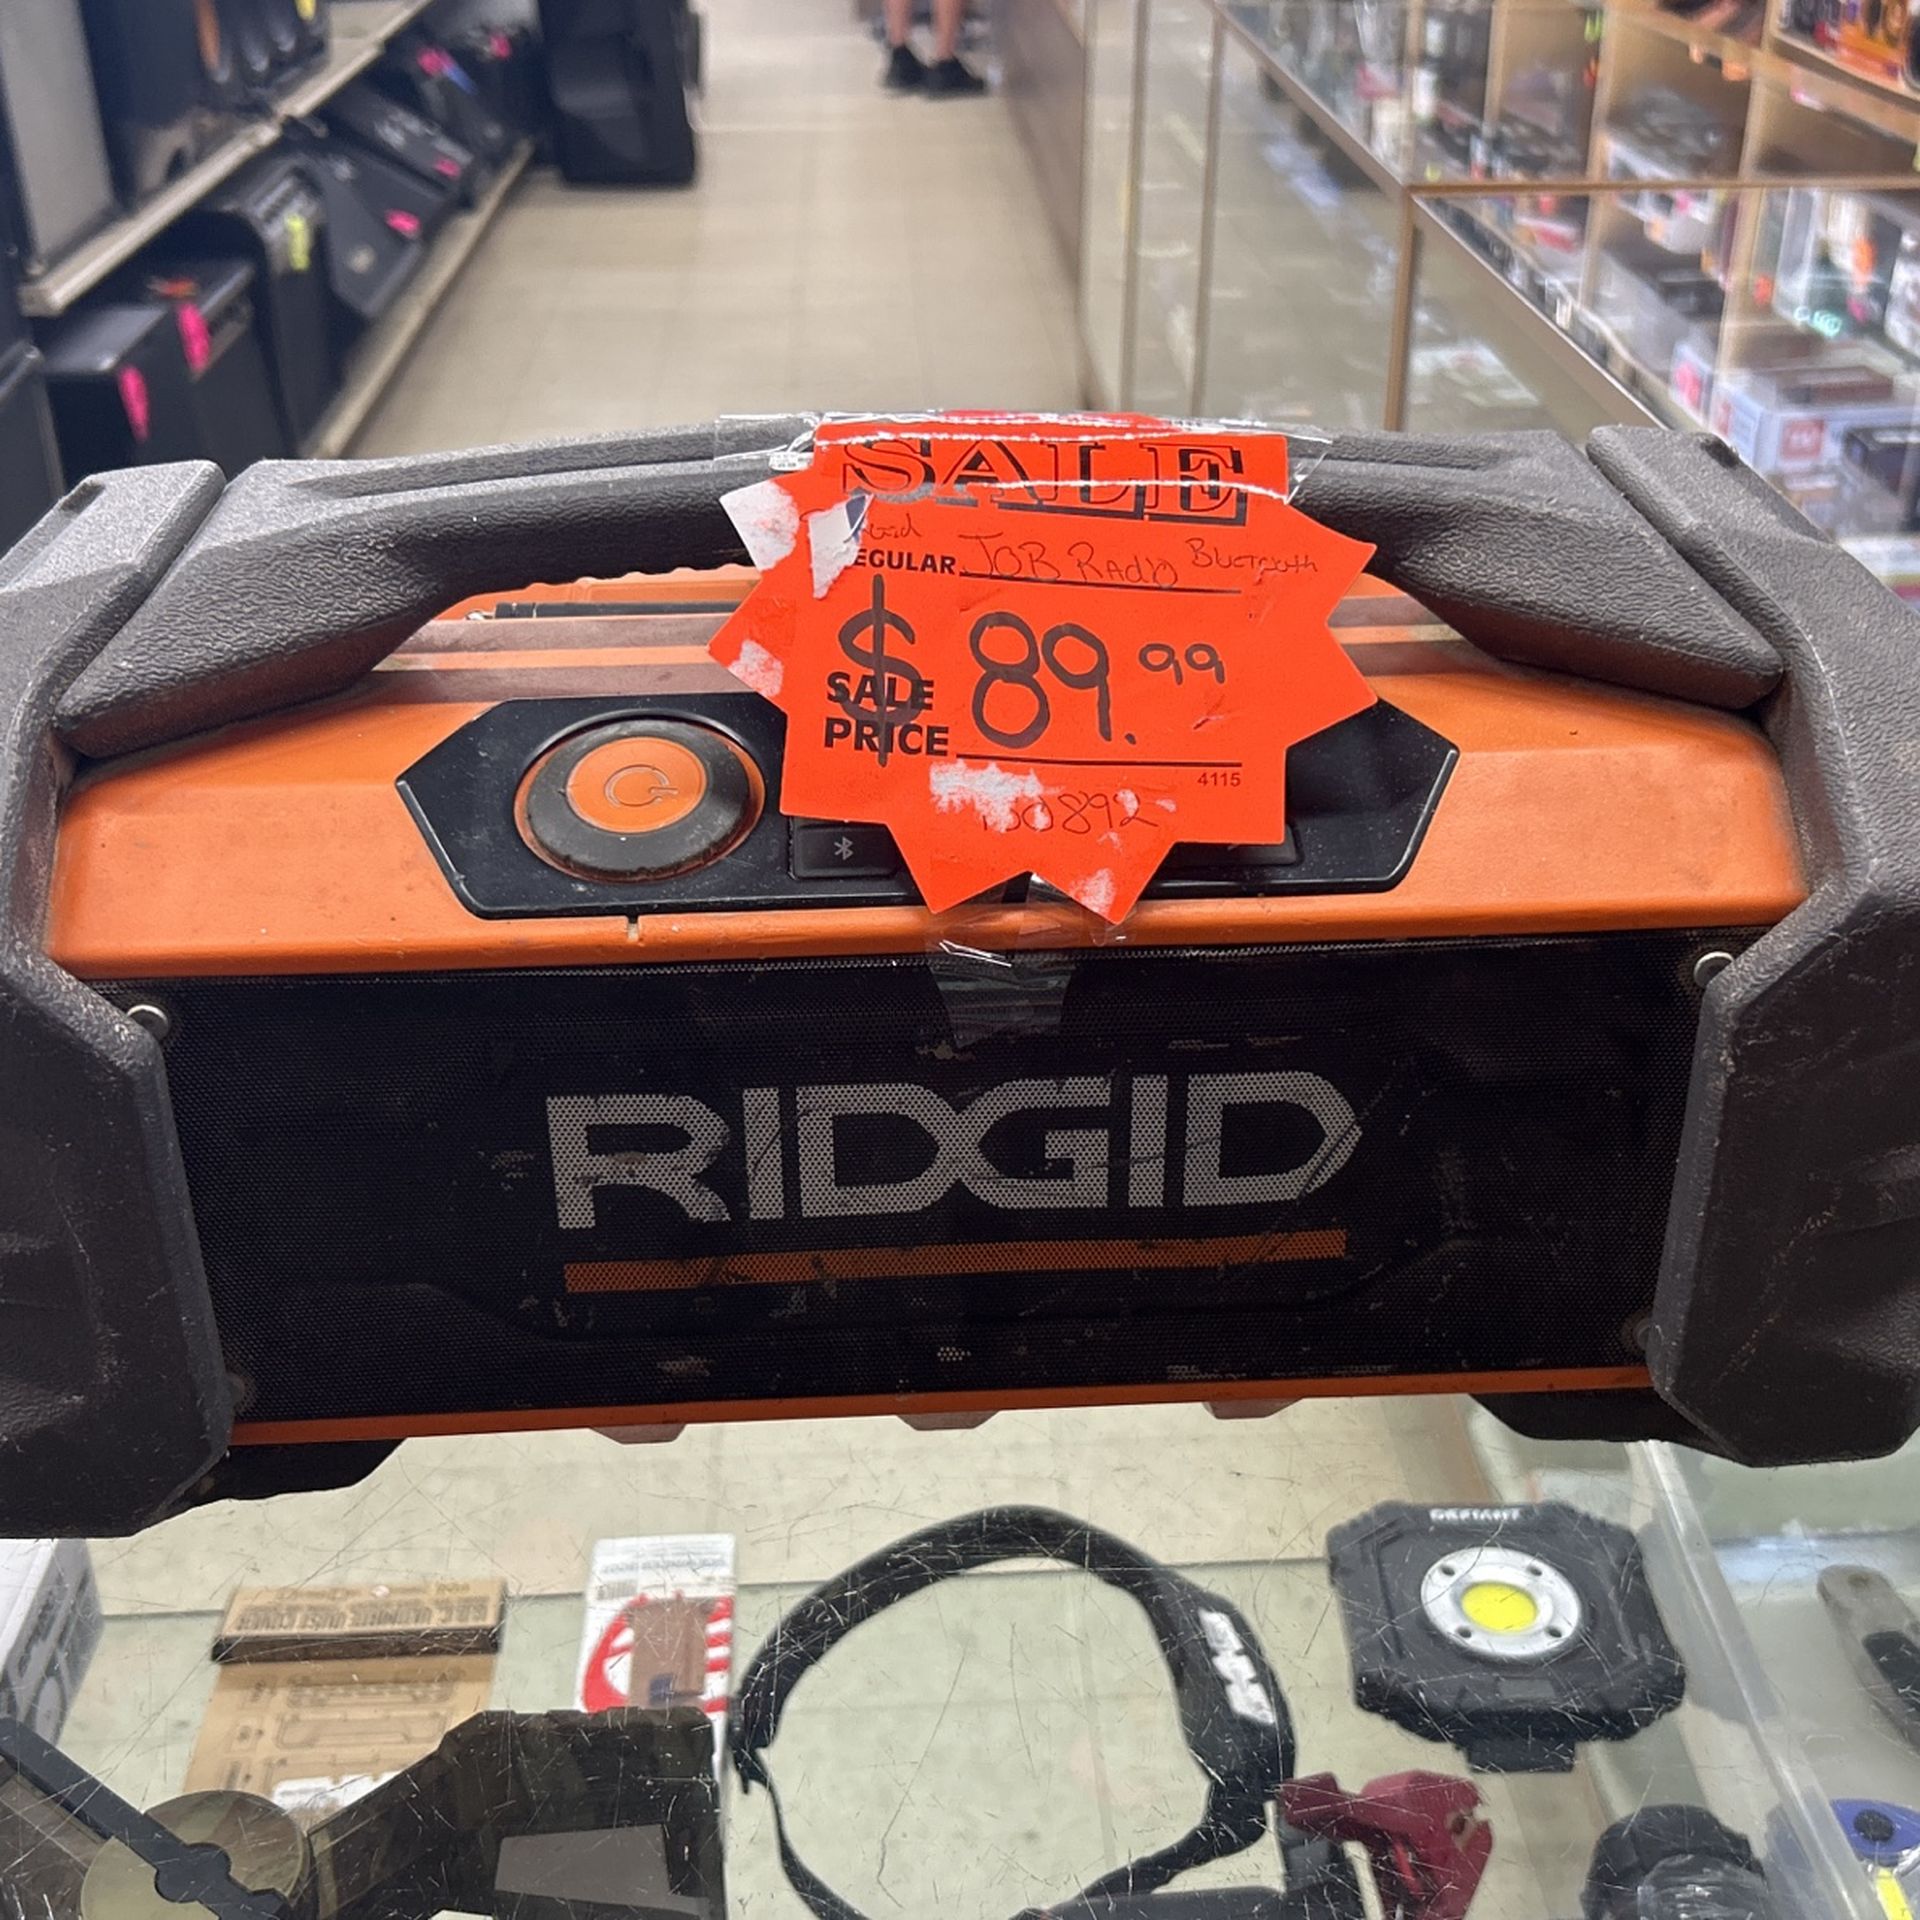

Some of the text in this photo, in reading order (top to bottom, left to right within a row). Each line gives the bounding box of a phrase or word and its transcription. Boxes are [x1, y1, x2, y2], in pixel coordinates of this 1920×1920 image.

[845, 437, 1246, 526] SALE
[854, 549, 956, 575] EGULAR
[827, 671, 934, 711] SALE
[824, 717, 950, 757] PRICE
[1197, 772, 1242, 787] 4115
[546, 1071, 1363, 1229] RIDGID
